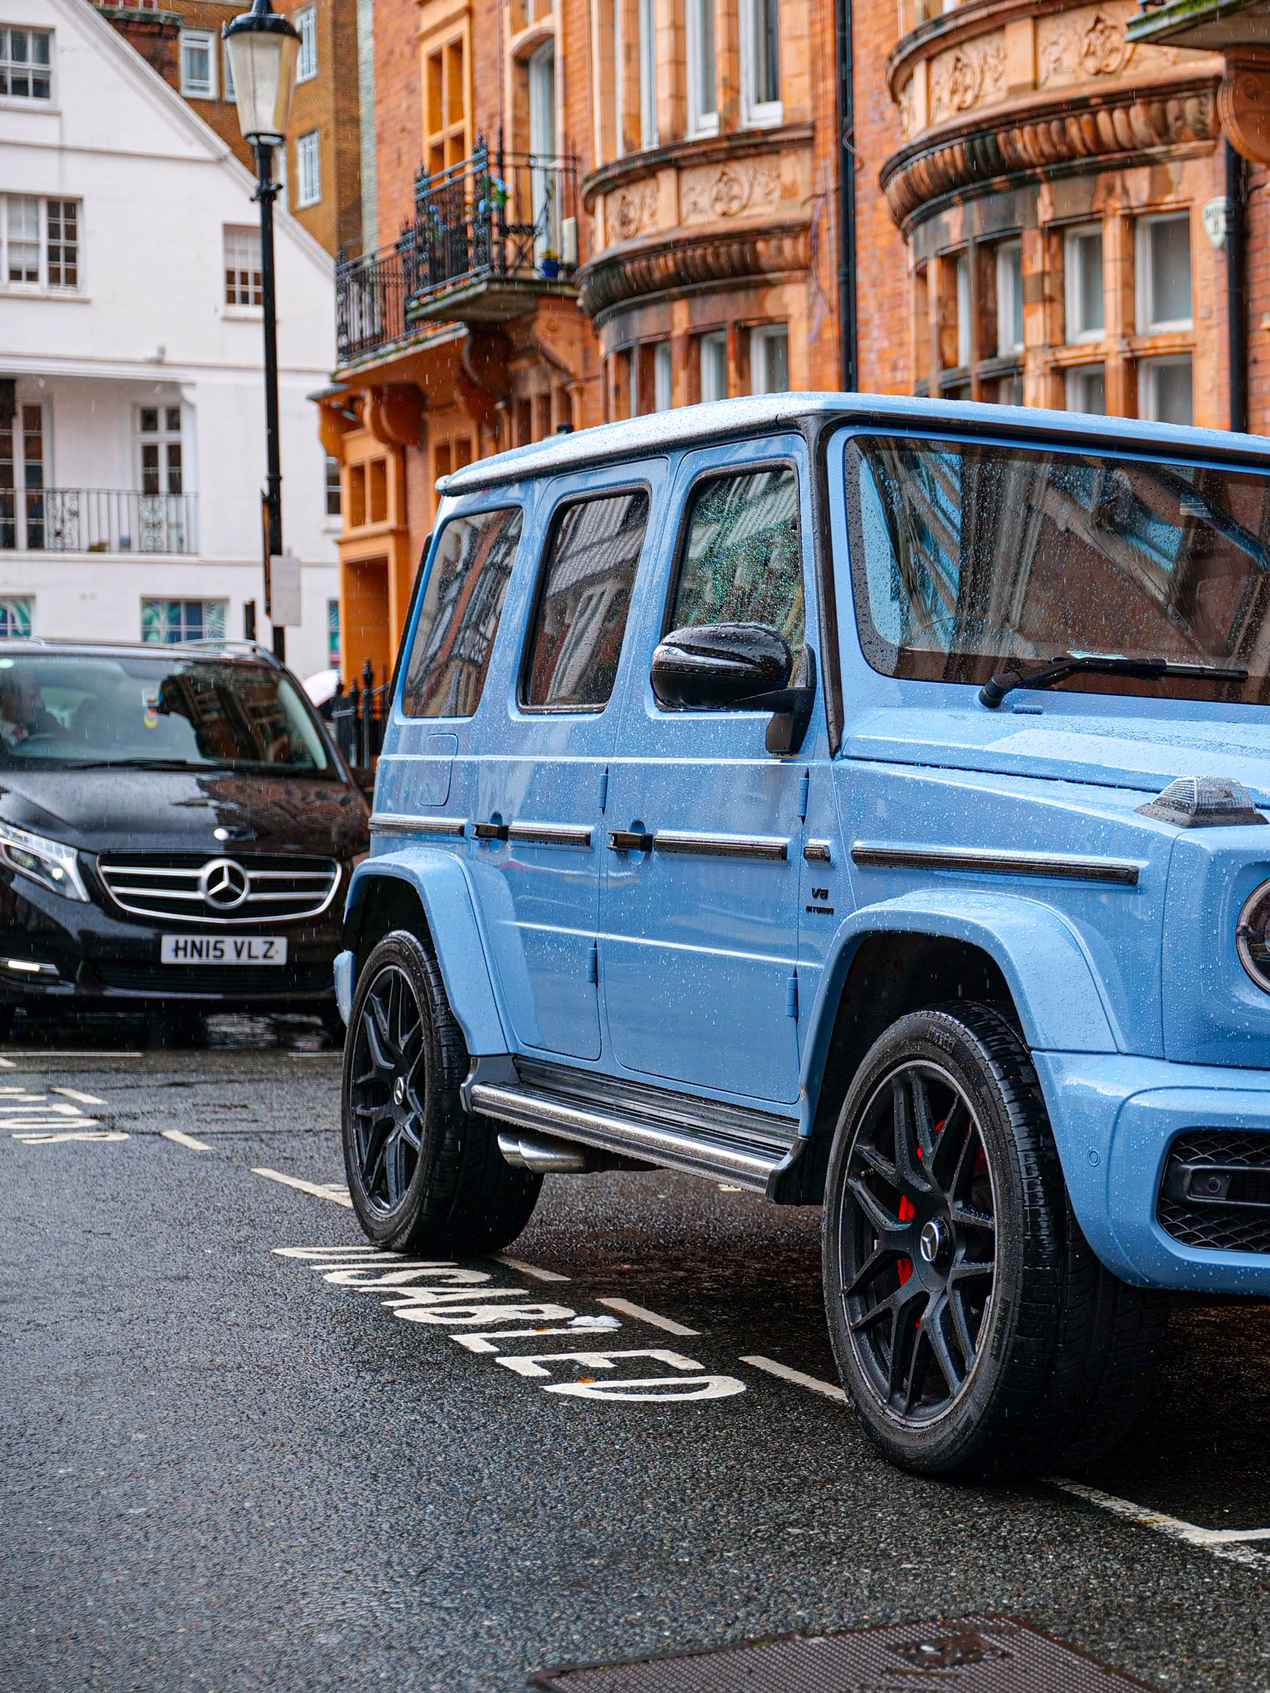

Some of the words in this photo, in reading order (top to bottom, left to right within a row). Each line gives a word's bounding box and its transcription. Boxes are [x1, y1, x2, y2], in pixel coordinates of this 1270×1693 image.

[812, 887, 829, 900] V8
[175, 940, 225, 959] HN15
[234, 941, 274, 959] VLZ
